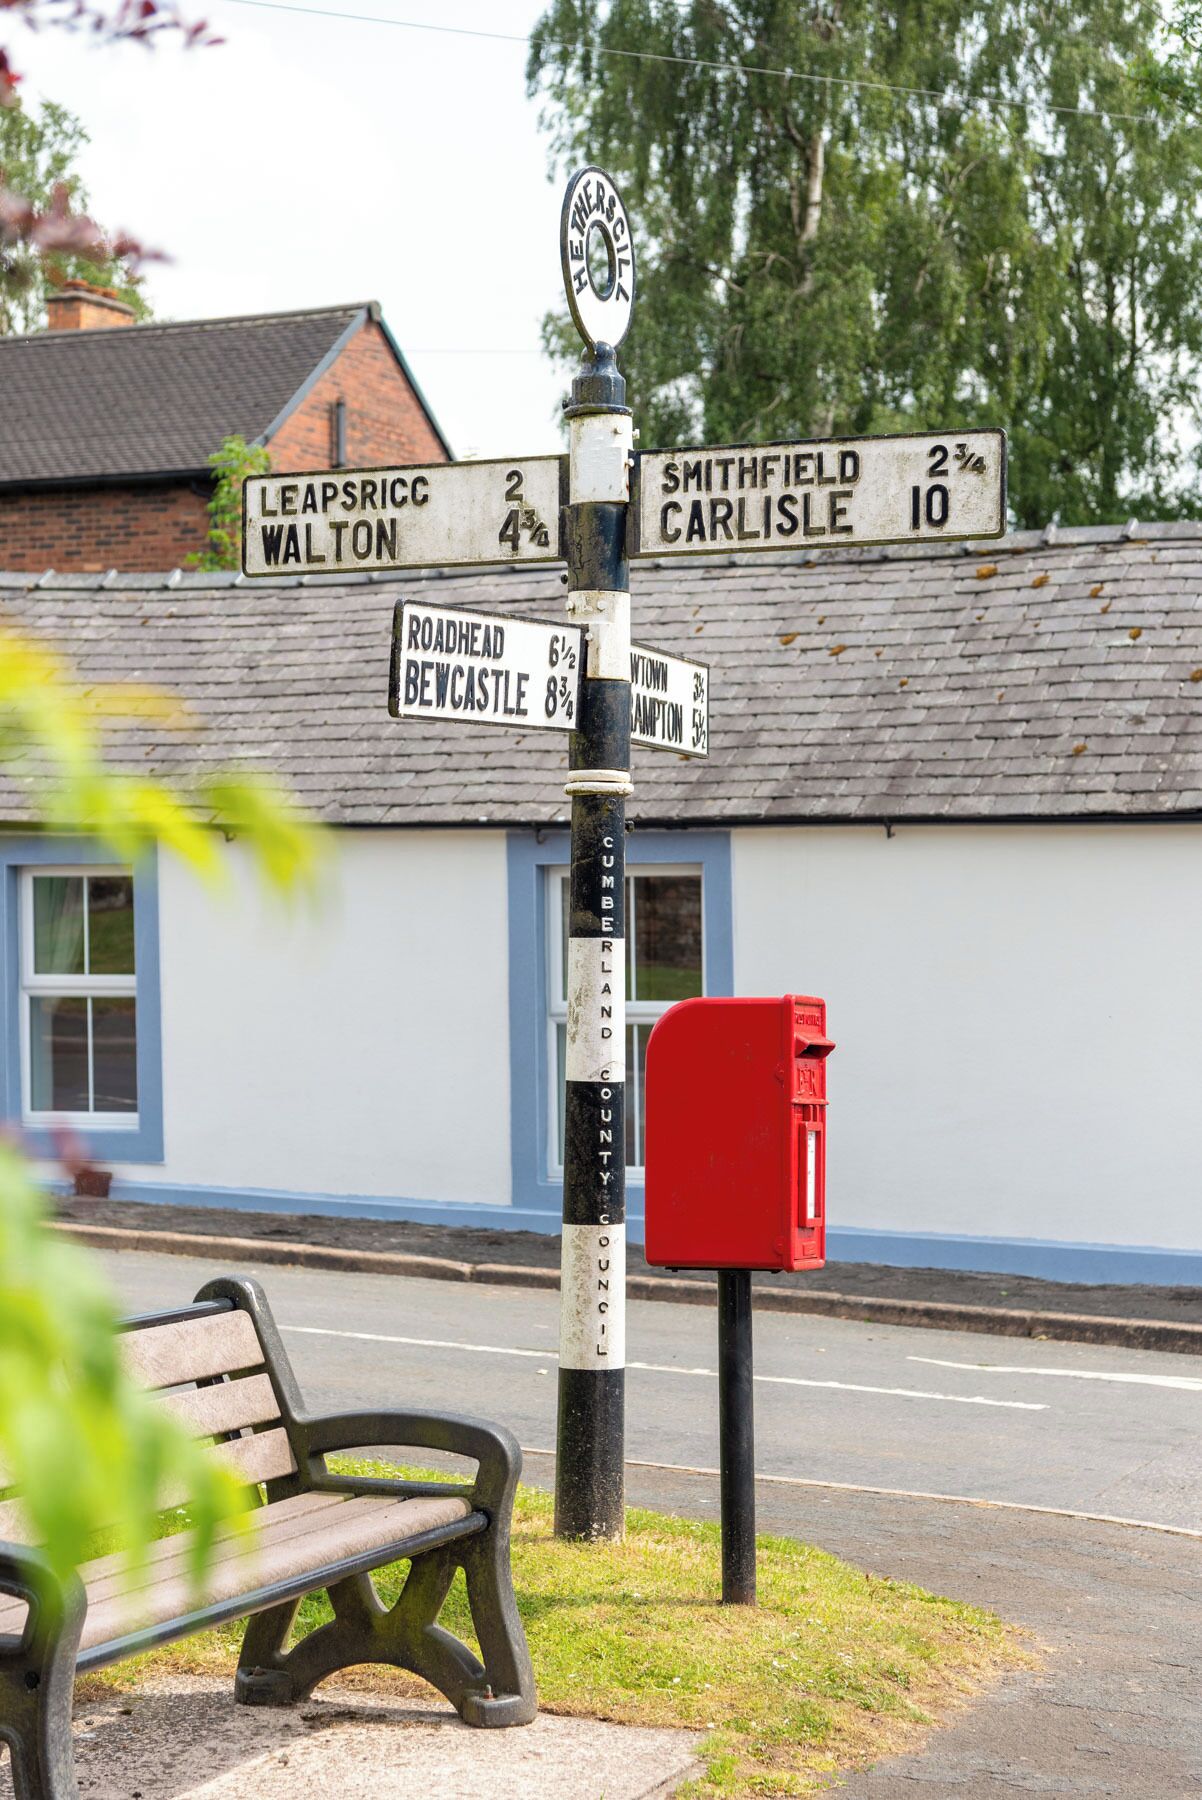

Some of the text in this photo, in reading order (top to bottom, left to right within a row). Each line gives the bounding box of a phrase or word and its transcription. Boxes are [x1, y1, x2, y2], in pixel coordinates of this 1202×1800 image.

[505, 470, 523, 501] 2
[661, 450, 860, 494] SMITHFIELD
[660, 484, 949, 543] CARLISLE 10
[261, 518, 397, 566] WALTON
[408, 614, 505, 659] ROADHEAD
[404, 659, 530, 716] BEWCASTLE
[597, 836, 615, 1355] CUMBERLAND COUNTY COUNCIL
